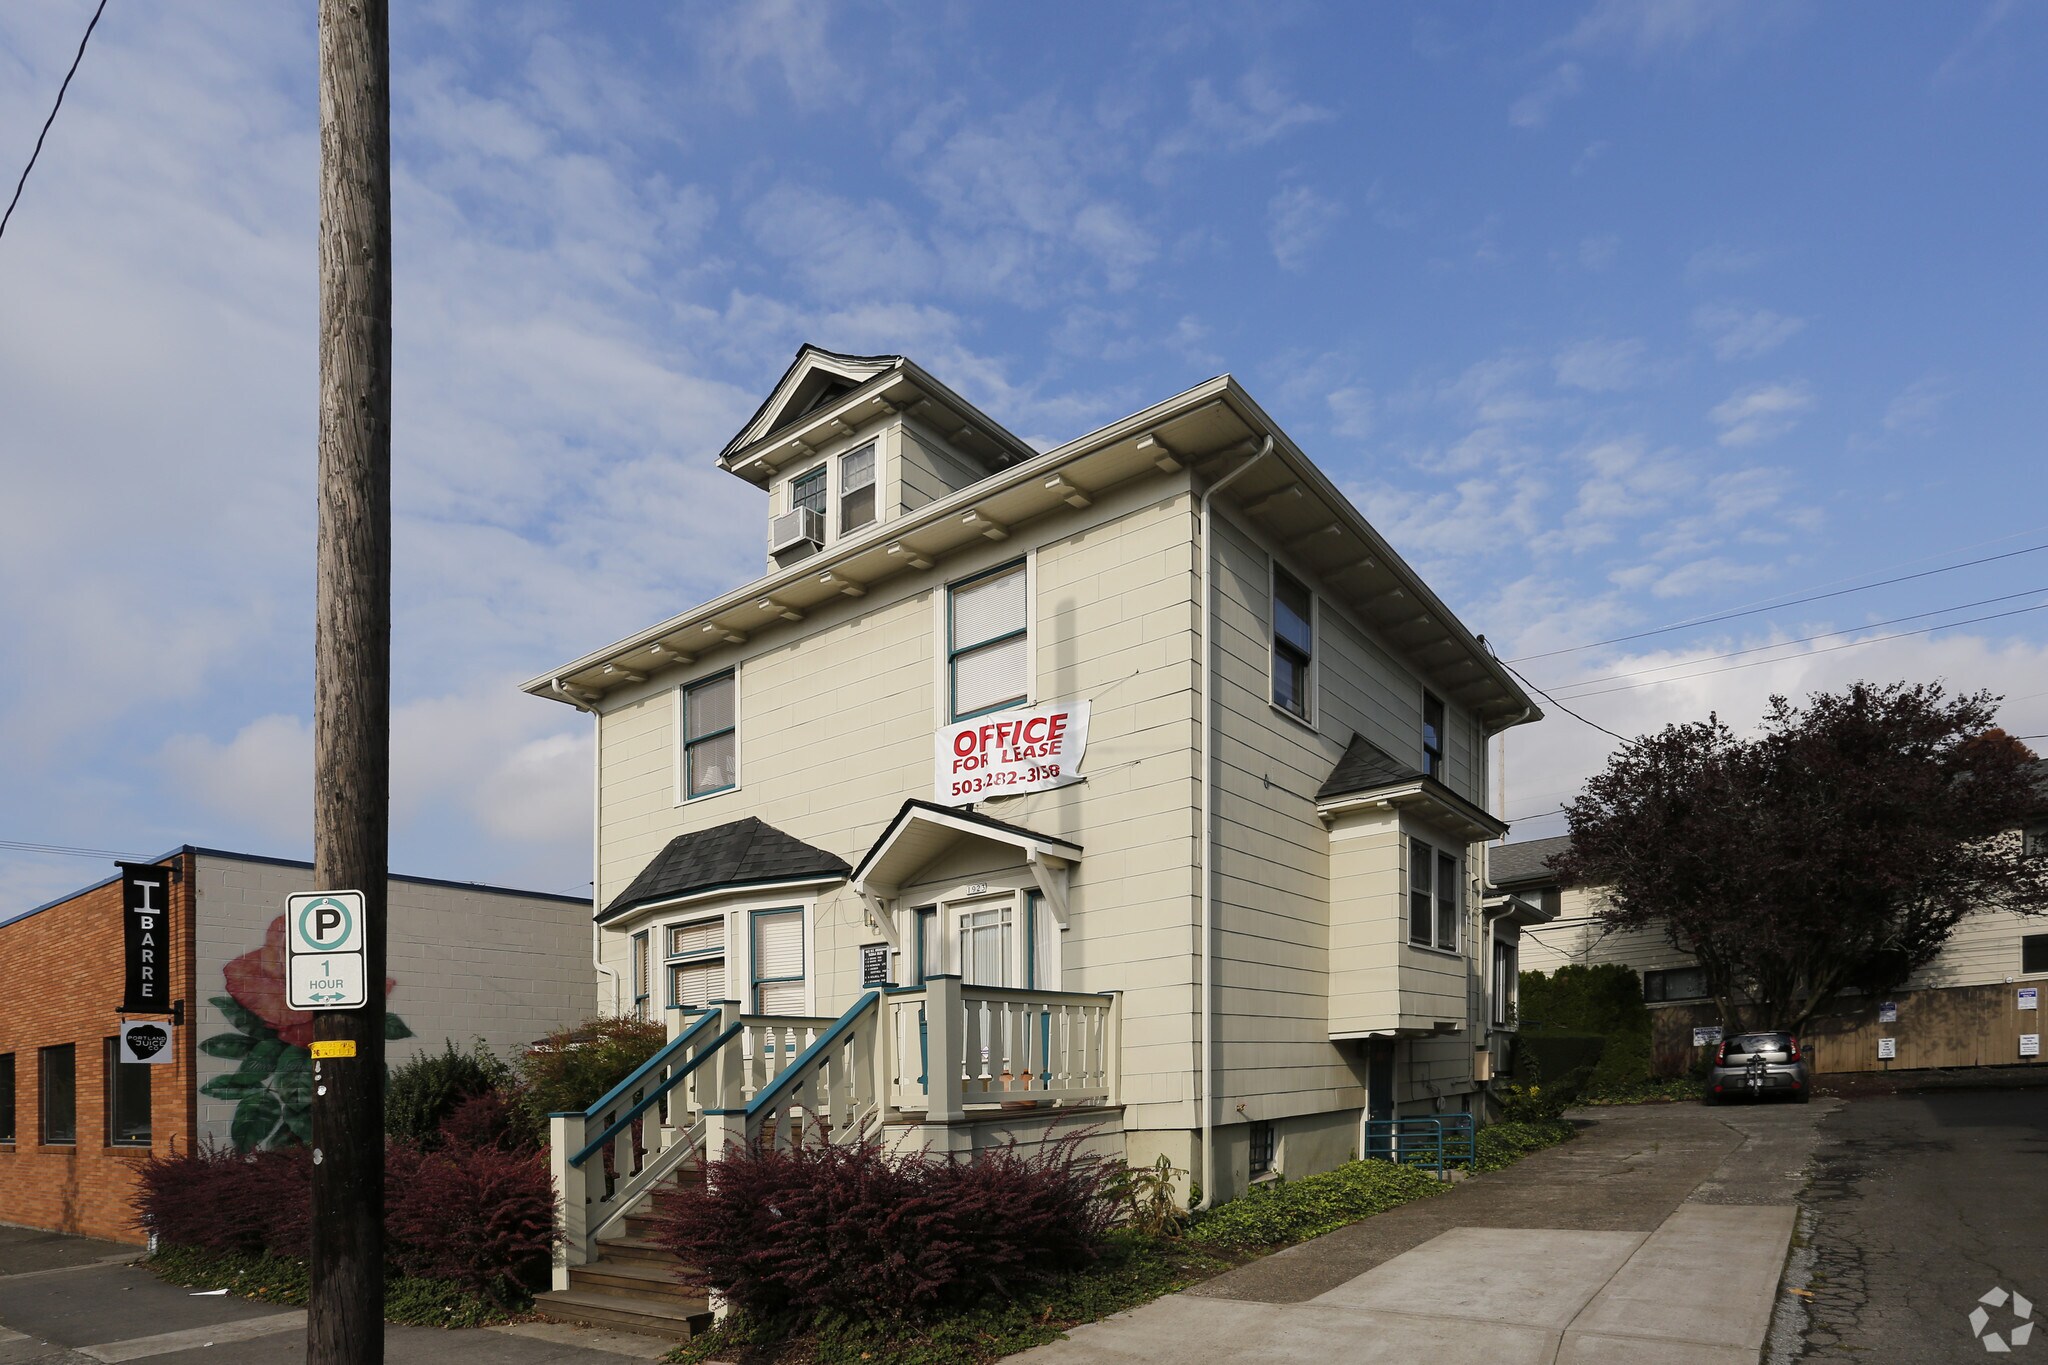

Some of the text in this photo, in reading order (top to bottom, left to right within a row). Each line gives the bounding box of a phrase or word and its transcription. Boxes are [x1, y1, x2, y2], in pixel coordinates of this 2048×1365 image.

[953, 713, 1068, 757] OFFICE
[953, 740, 1062, 774] FOR LEASE
[967, 884, 986, 894] 1923
[316, 909, 341, 940] P
[141, 917, 154, 997] BARRE
[321, 960, 330, 976] 1
[309, 979, 343, 989] HOUR
